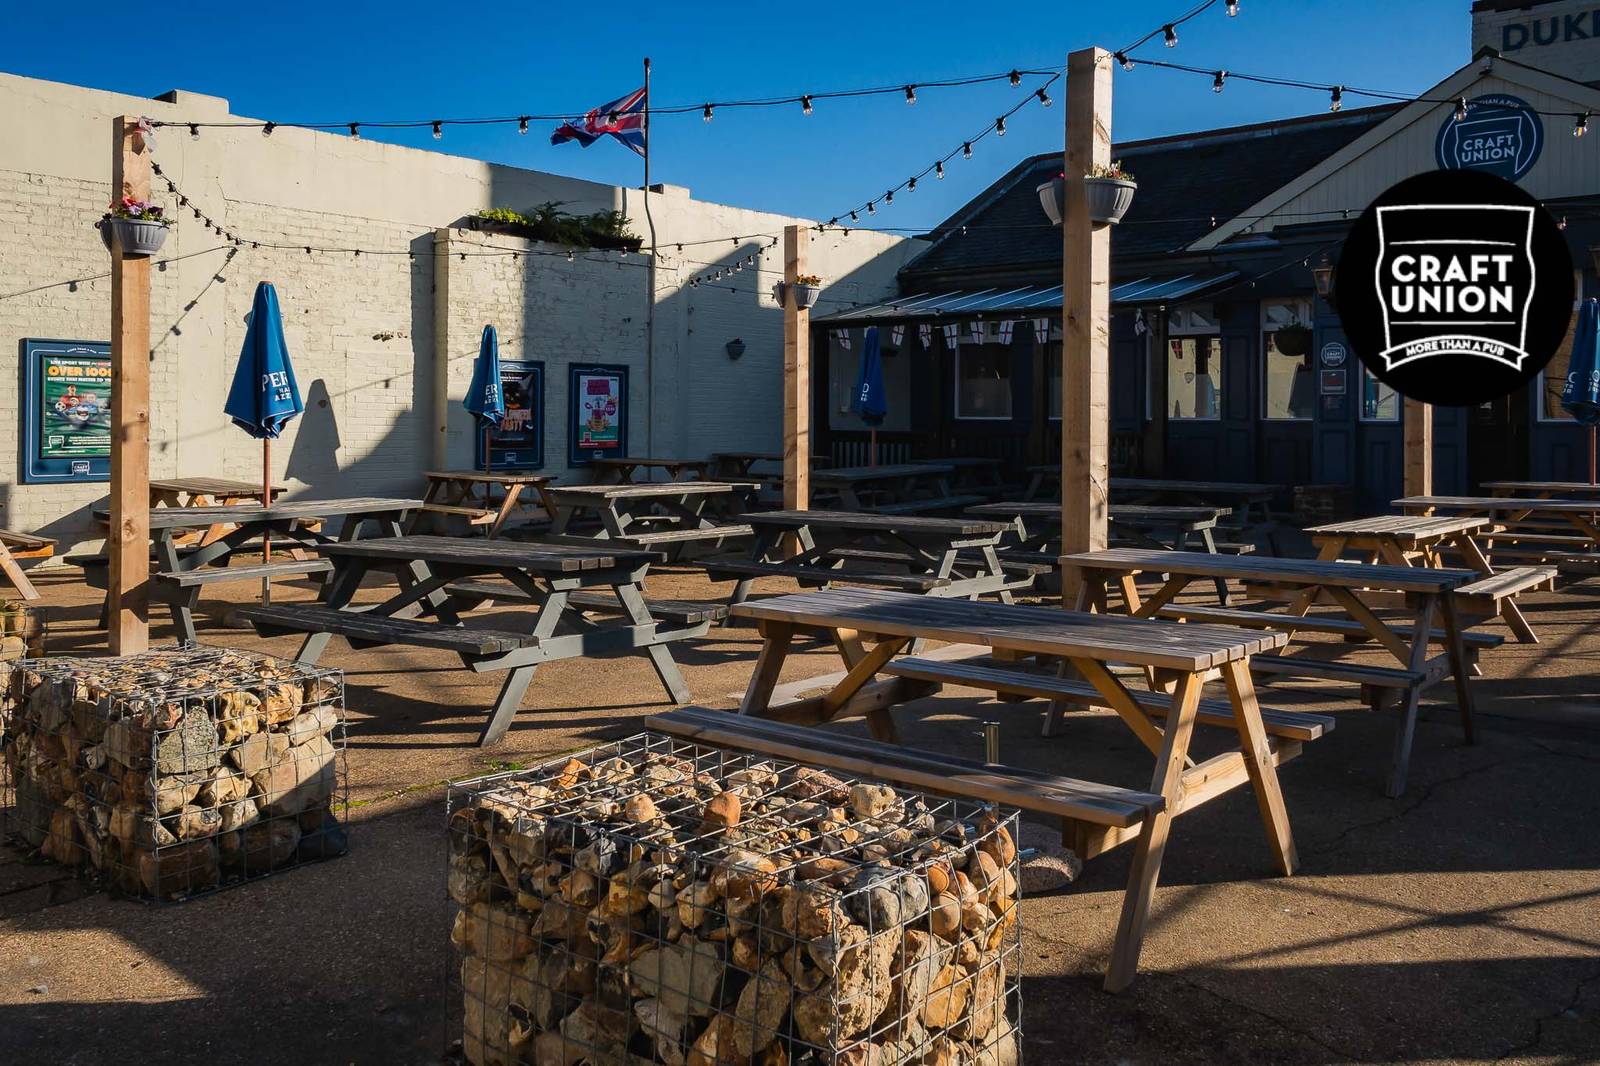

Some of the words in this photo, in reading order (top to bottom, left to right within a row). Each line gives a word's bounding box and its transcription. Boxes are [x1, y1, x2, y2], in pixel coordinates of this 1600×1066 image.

[1462, 134, 1514, 151] CRAFT
[1461, 145, 1515, 162] UNION
[48, 366, 83, 377] OVER
